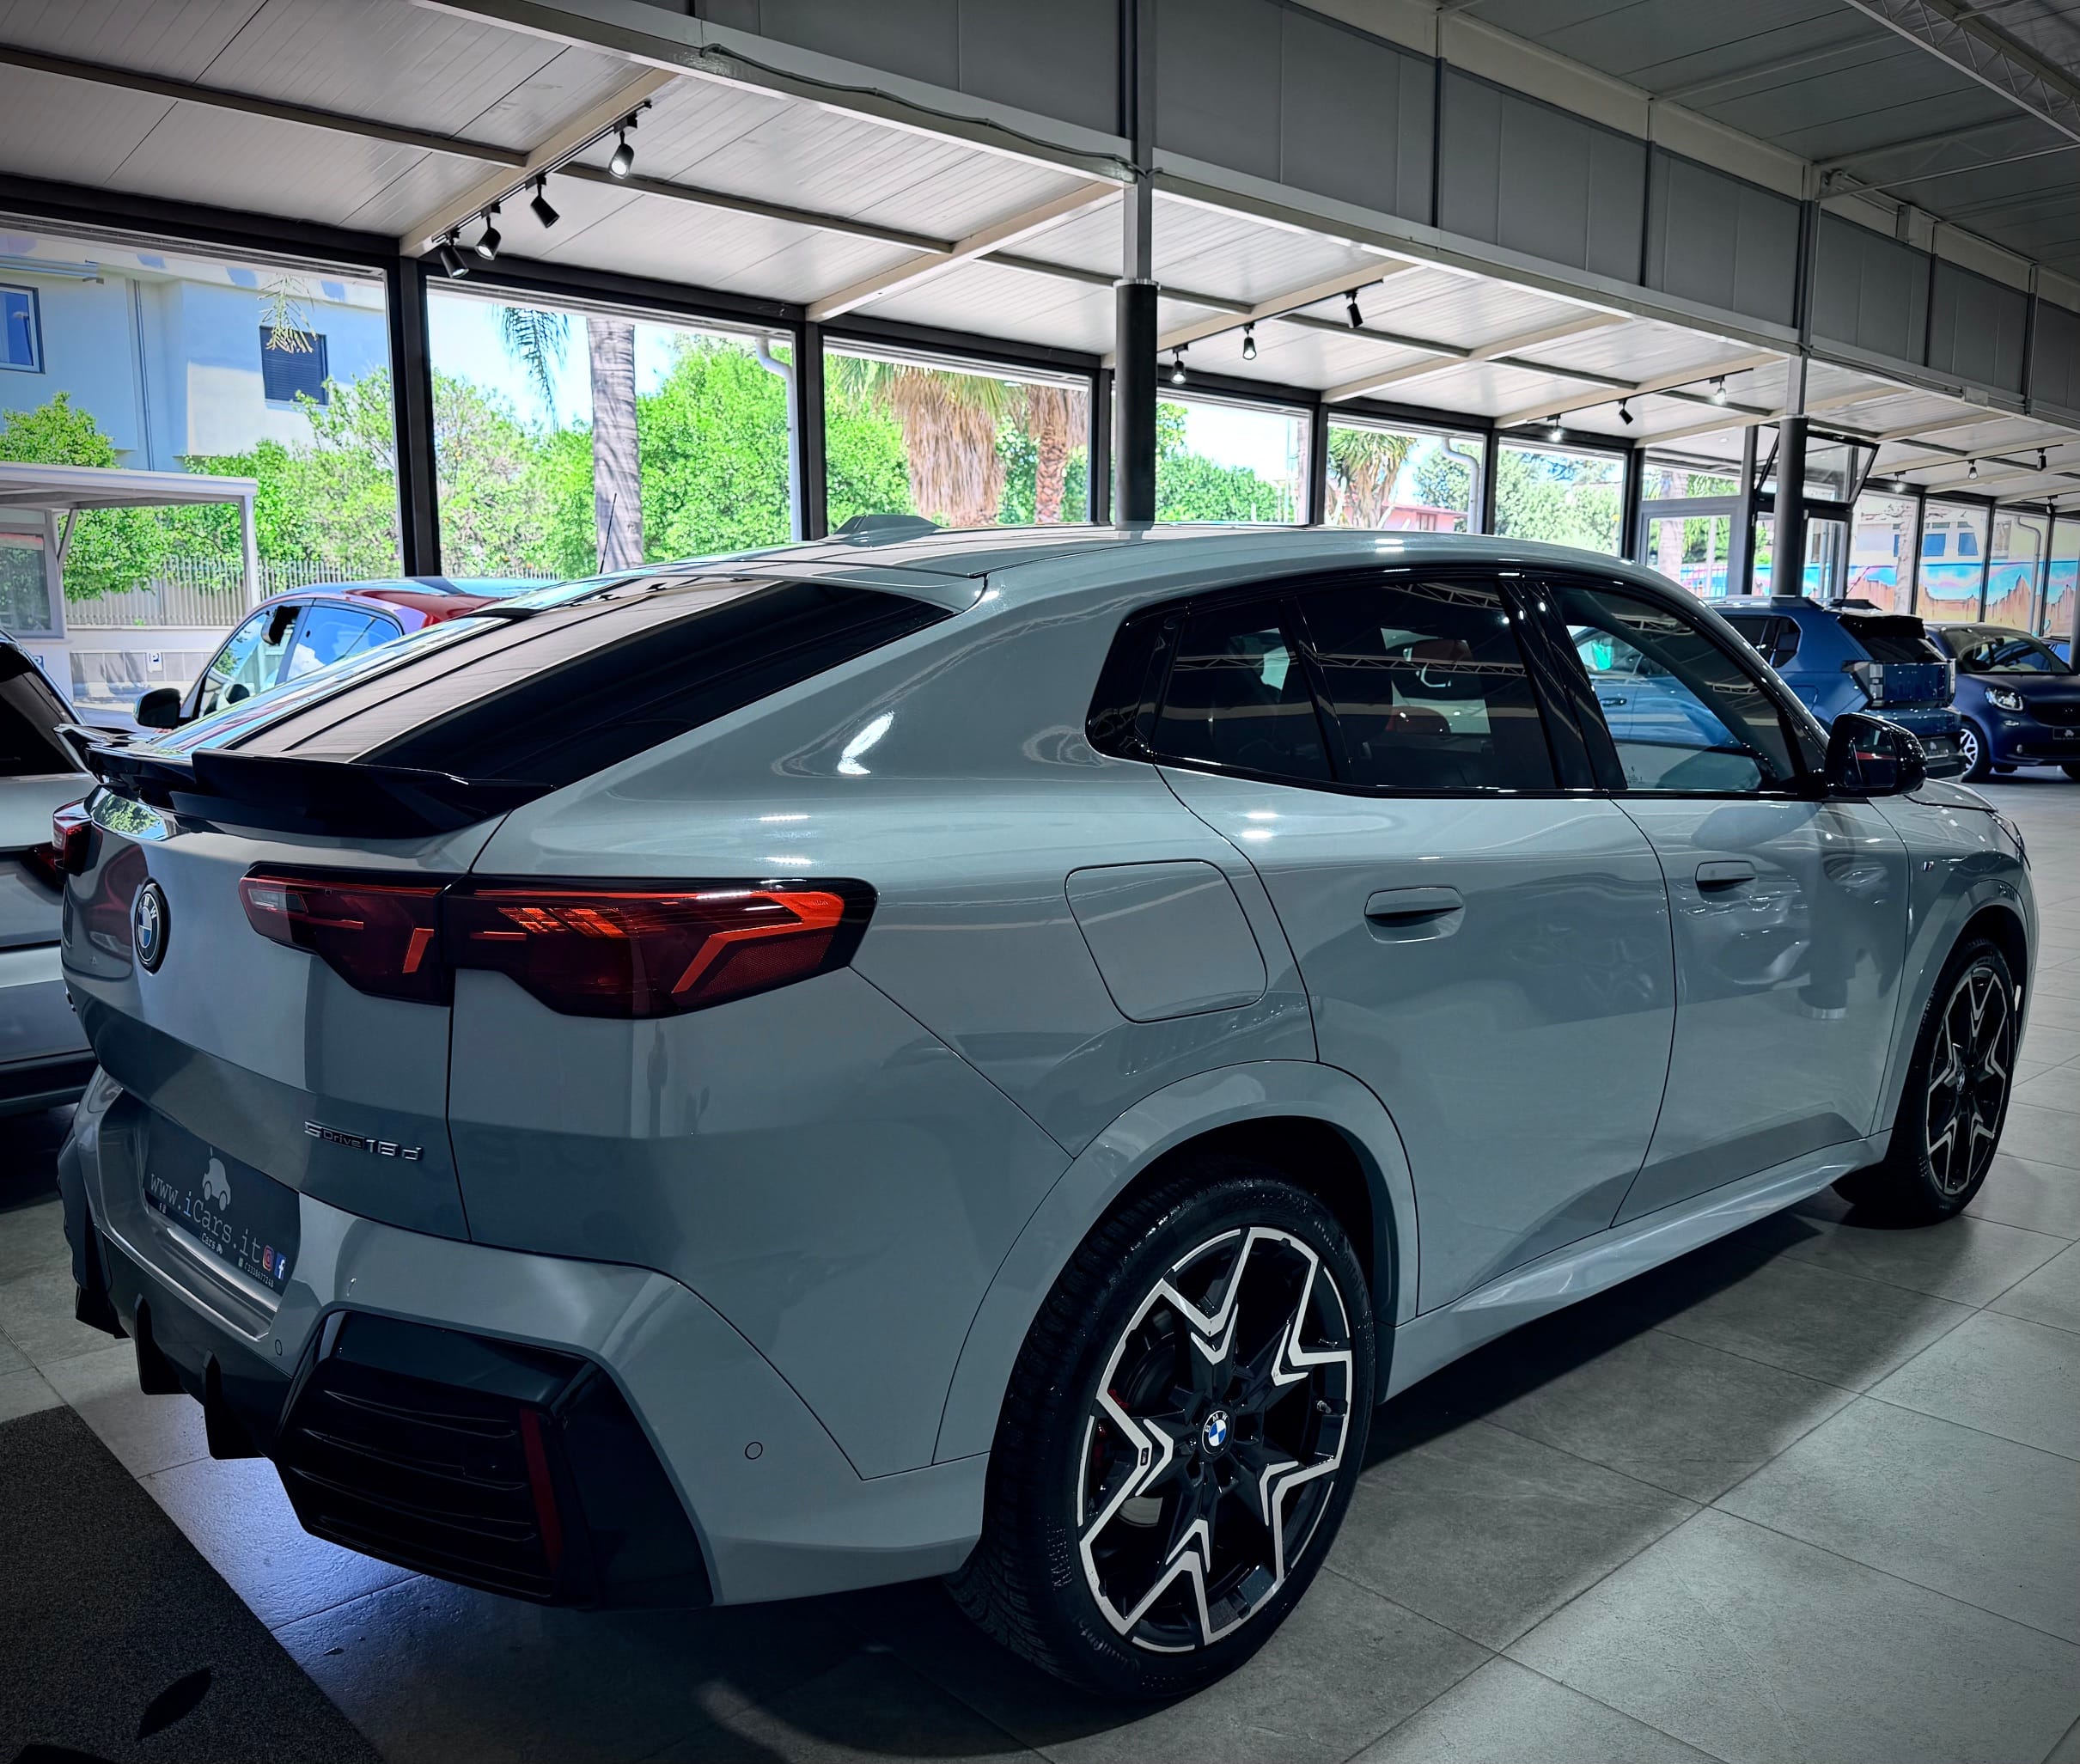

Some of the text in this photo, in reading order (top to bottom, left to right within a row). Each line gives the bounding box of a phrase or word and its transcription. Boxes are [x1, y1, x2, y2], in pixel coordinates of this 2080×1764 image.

[138, 895, 157, 919] BMW
[150, 1173, 261, 1263] www.iCars.it
[1205, 1412, 1228, 1432] BMW
